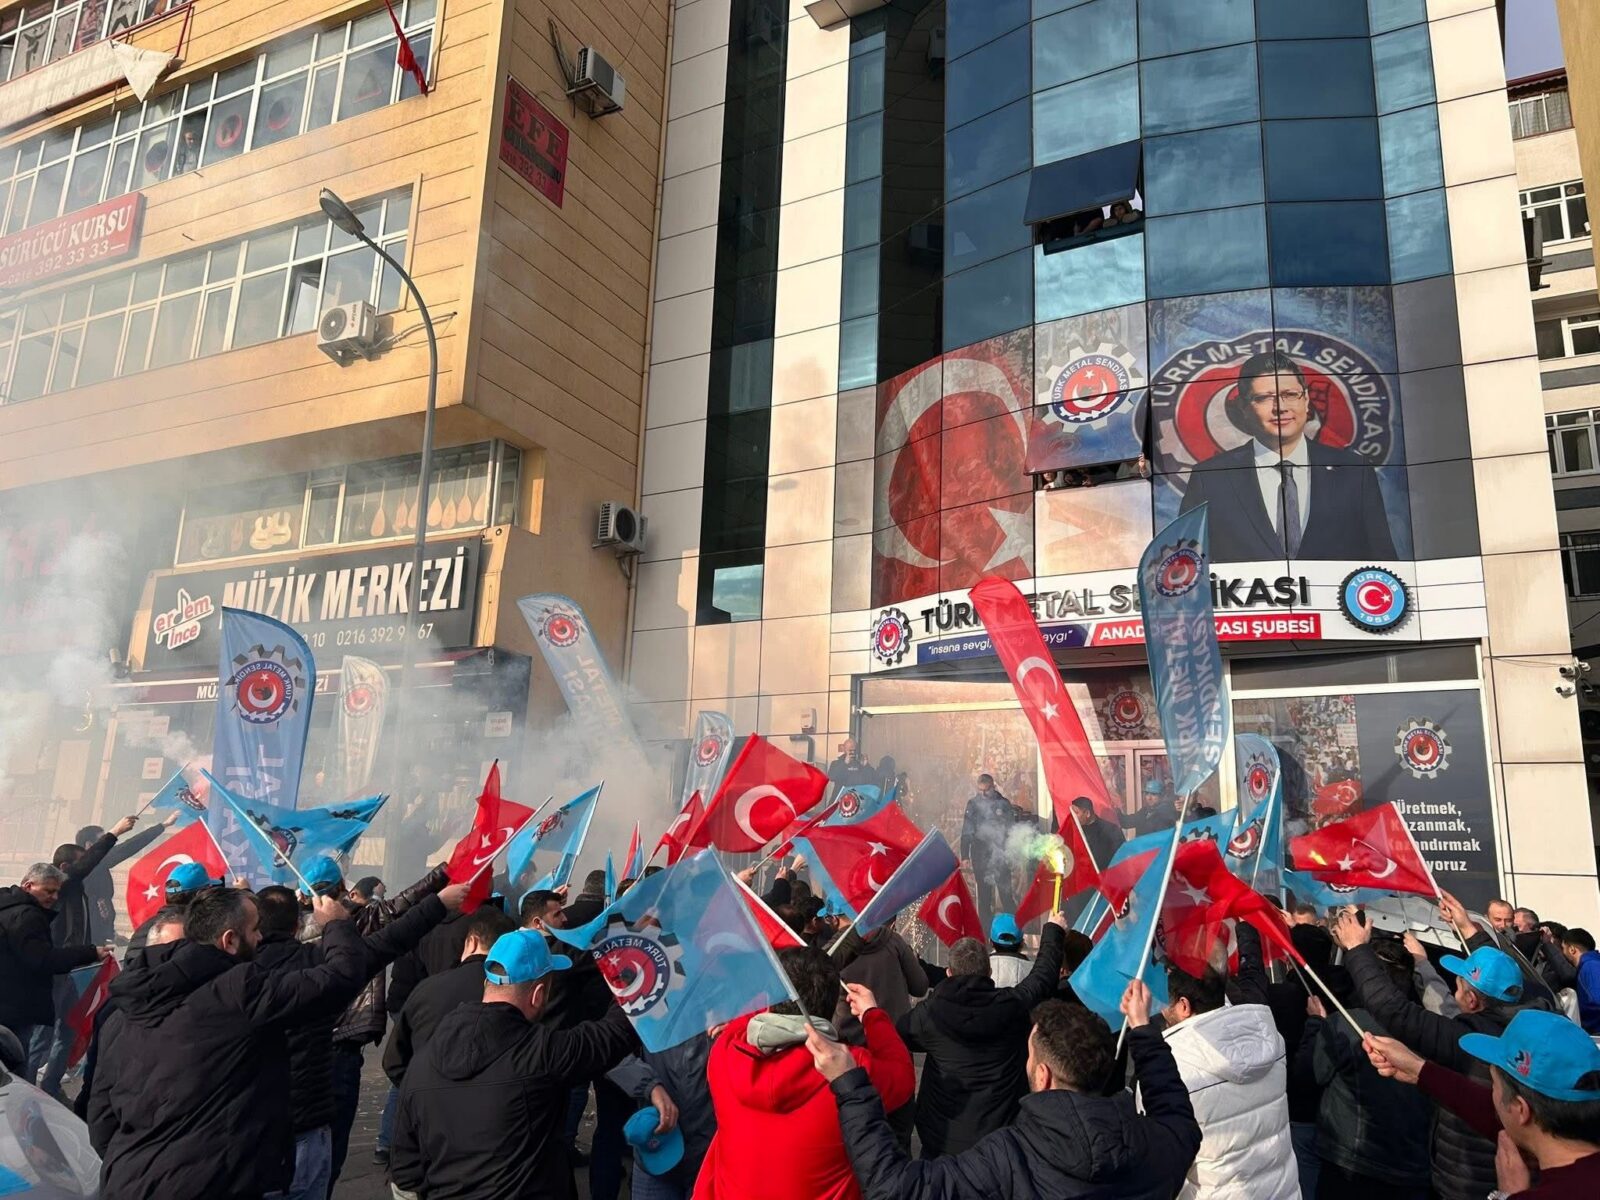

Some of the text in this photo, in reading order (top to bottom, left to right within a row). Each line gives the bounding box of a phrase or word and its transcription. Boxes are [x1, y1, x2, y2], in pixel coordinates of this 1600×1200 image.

[67, 205, 132, 248] KURSU
[35, 255, 63, 276] 392
[66, 247, 86, 266] 33
[89, 239, 109, 259] 33
[1063, 358, 1094, 379] METAL
[1206, 338, 1307, 362] METAL
[1315, 347, 1387, 461] SENDİKAS
[219, 546, 465, 628] MÜZİK MERKEZİ
[336, 629, 366, 647] 0216
[370, 626, 394, 643] 392
[418, 623, 434, 640] 67
[1252, 616, 1316, 637] ŞUBESİ
[1397, 799, 1462, 817] Üretmek,
